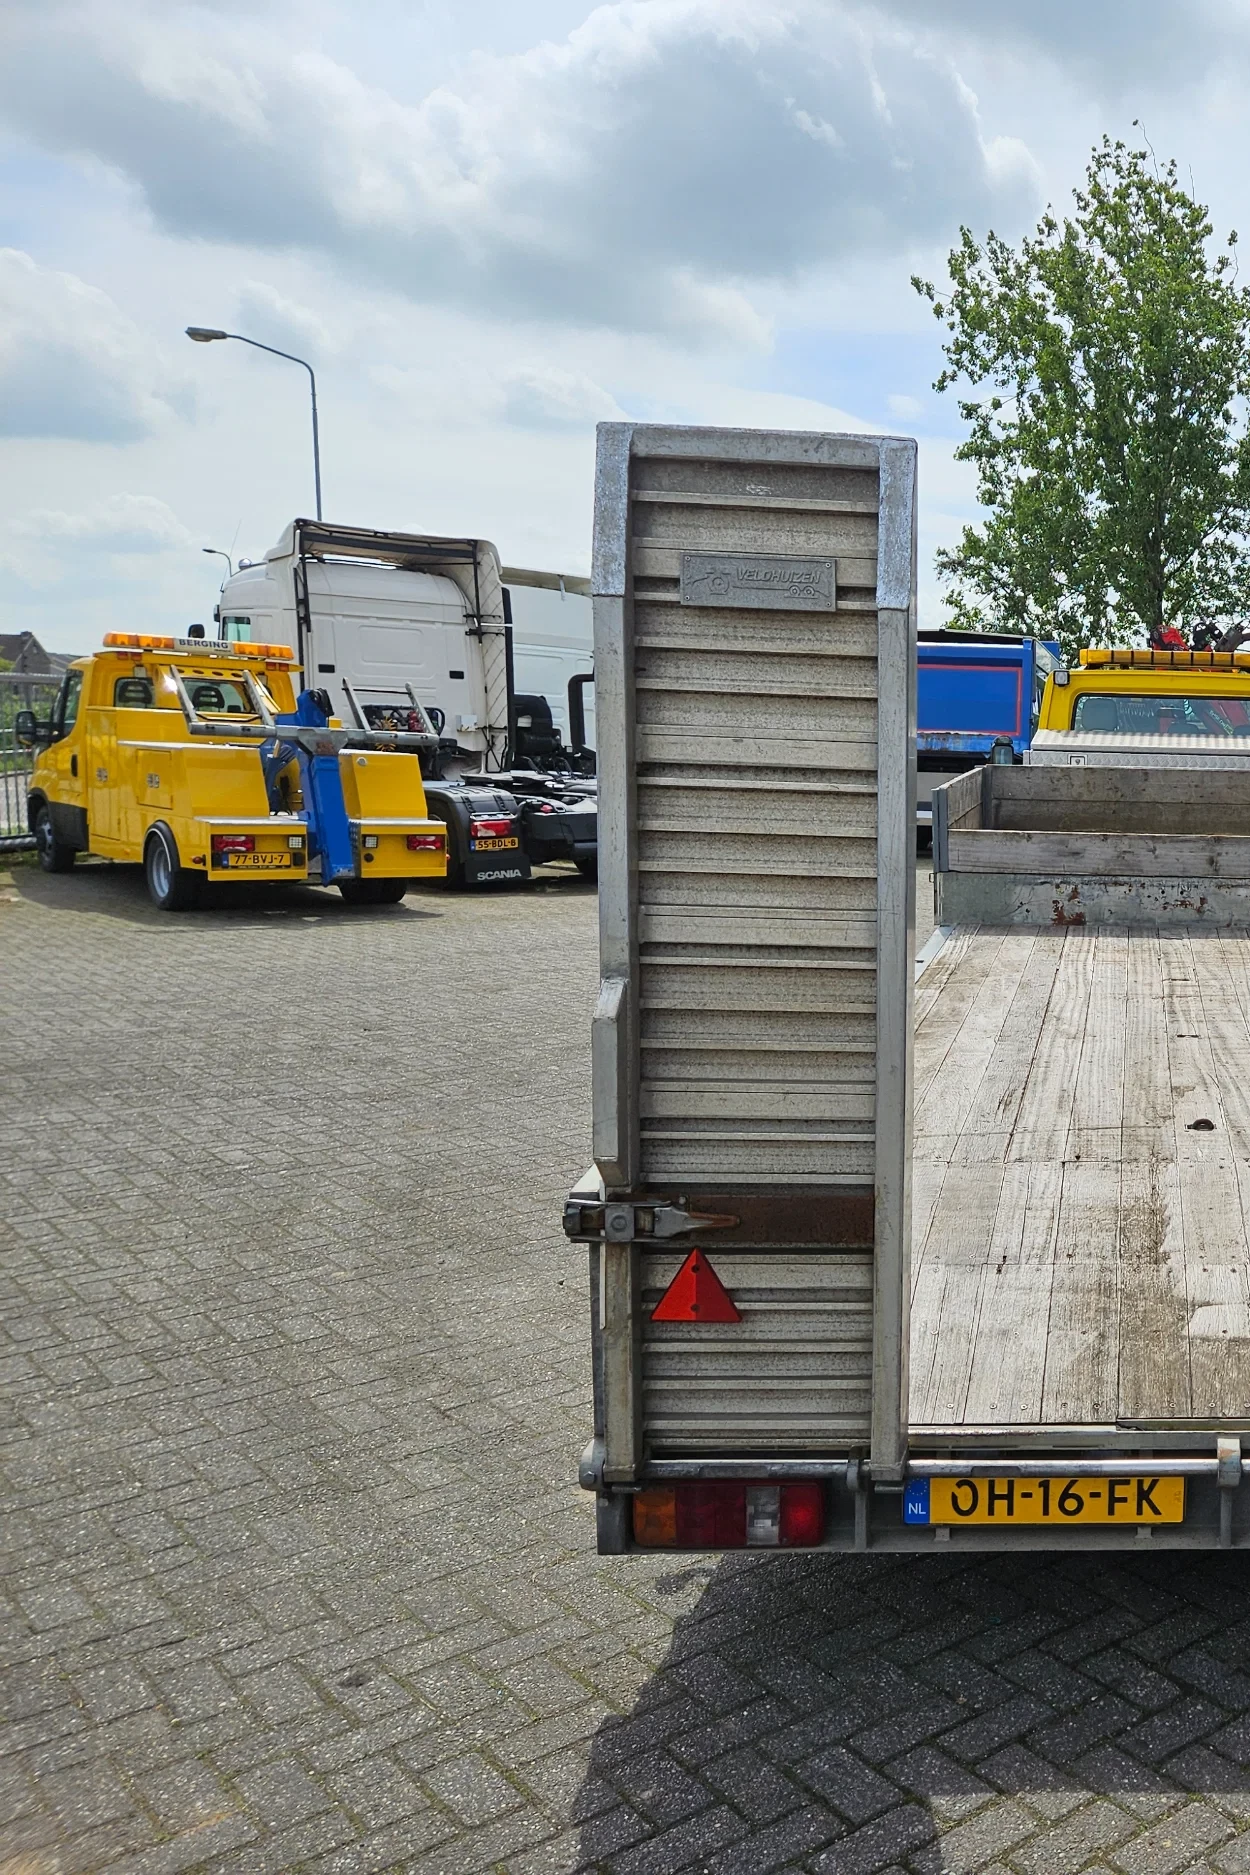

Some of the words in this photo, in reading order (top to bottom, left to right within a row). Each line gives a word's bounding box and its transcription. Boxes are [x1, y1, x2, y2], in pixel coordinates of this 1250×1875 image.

[736, 566, 822, 584] VELDHUIZEN
[179, 639, 229, 649] BERGING
[234, 854, 285, 864] 77-BVJ-7
[477, 869, 522, 880] SCANIA
[951, 1478, 1163, 1517] OH-16-FK
[908, 1502, 926, 1515] NL
